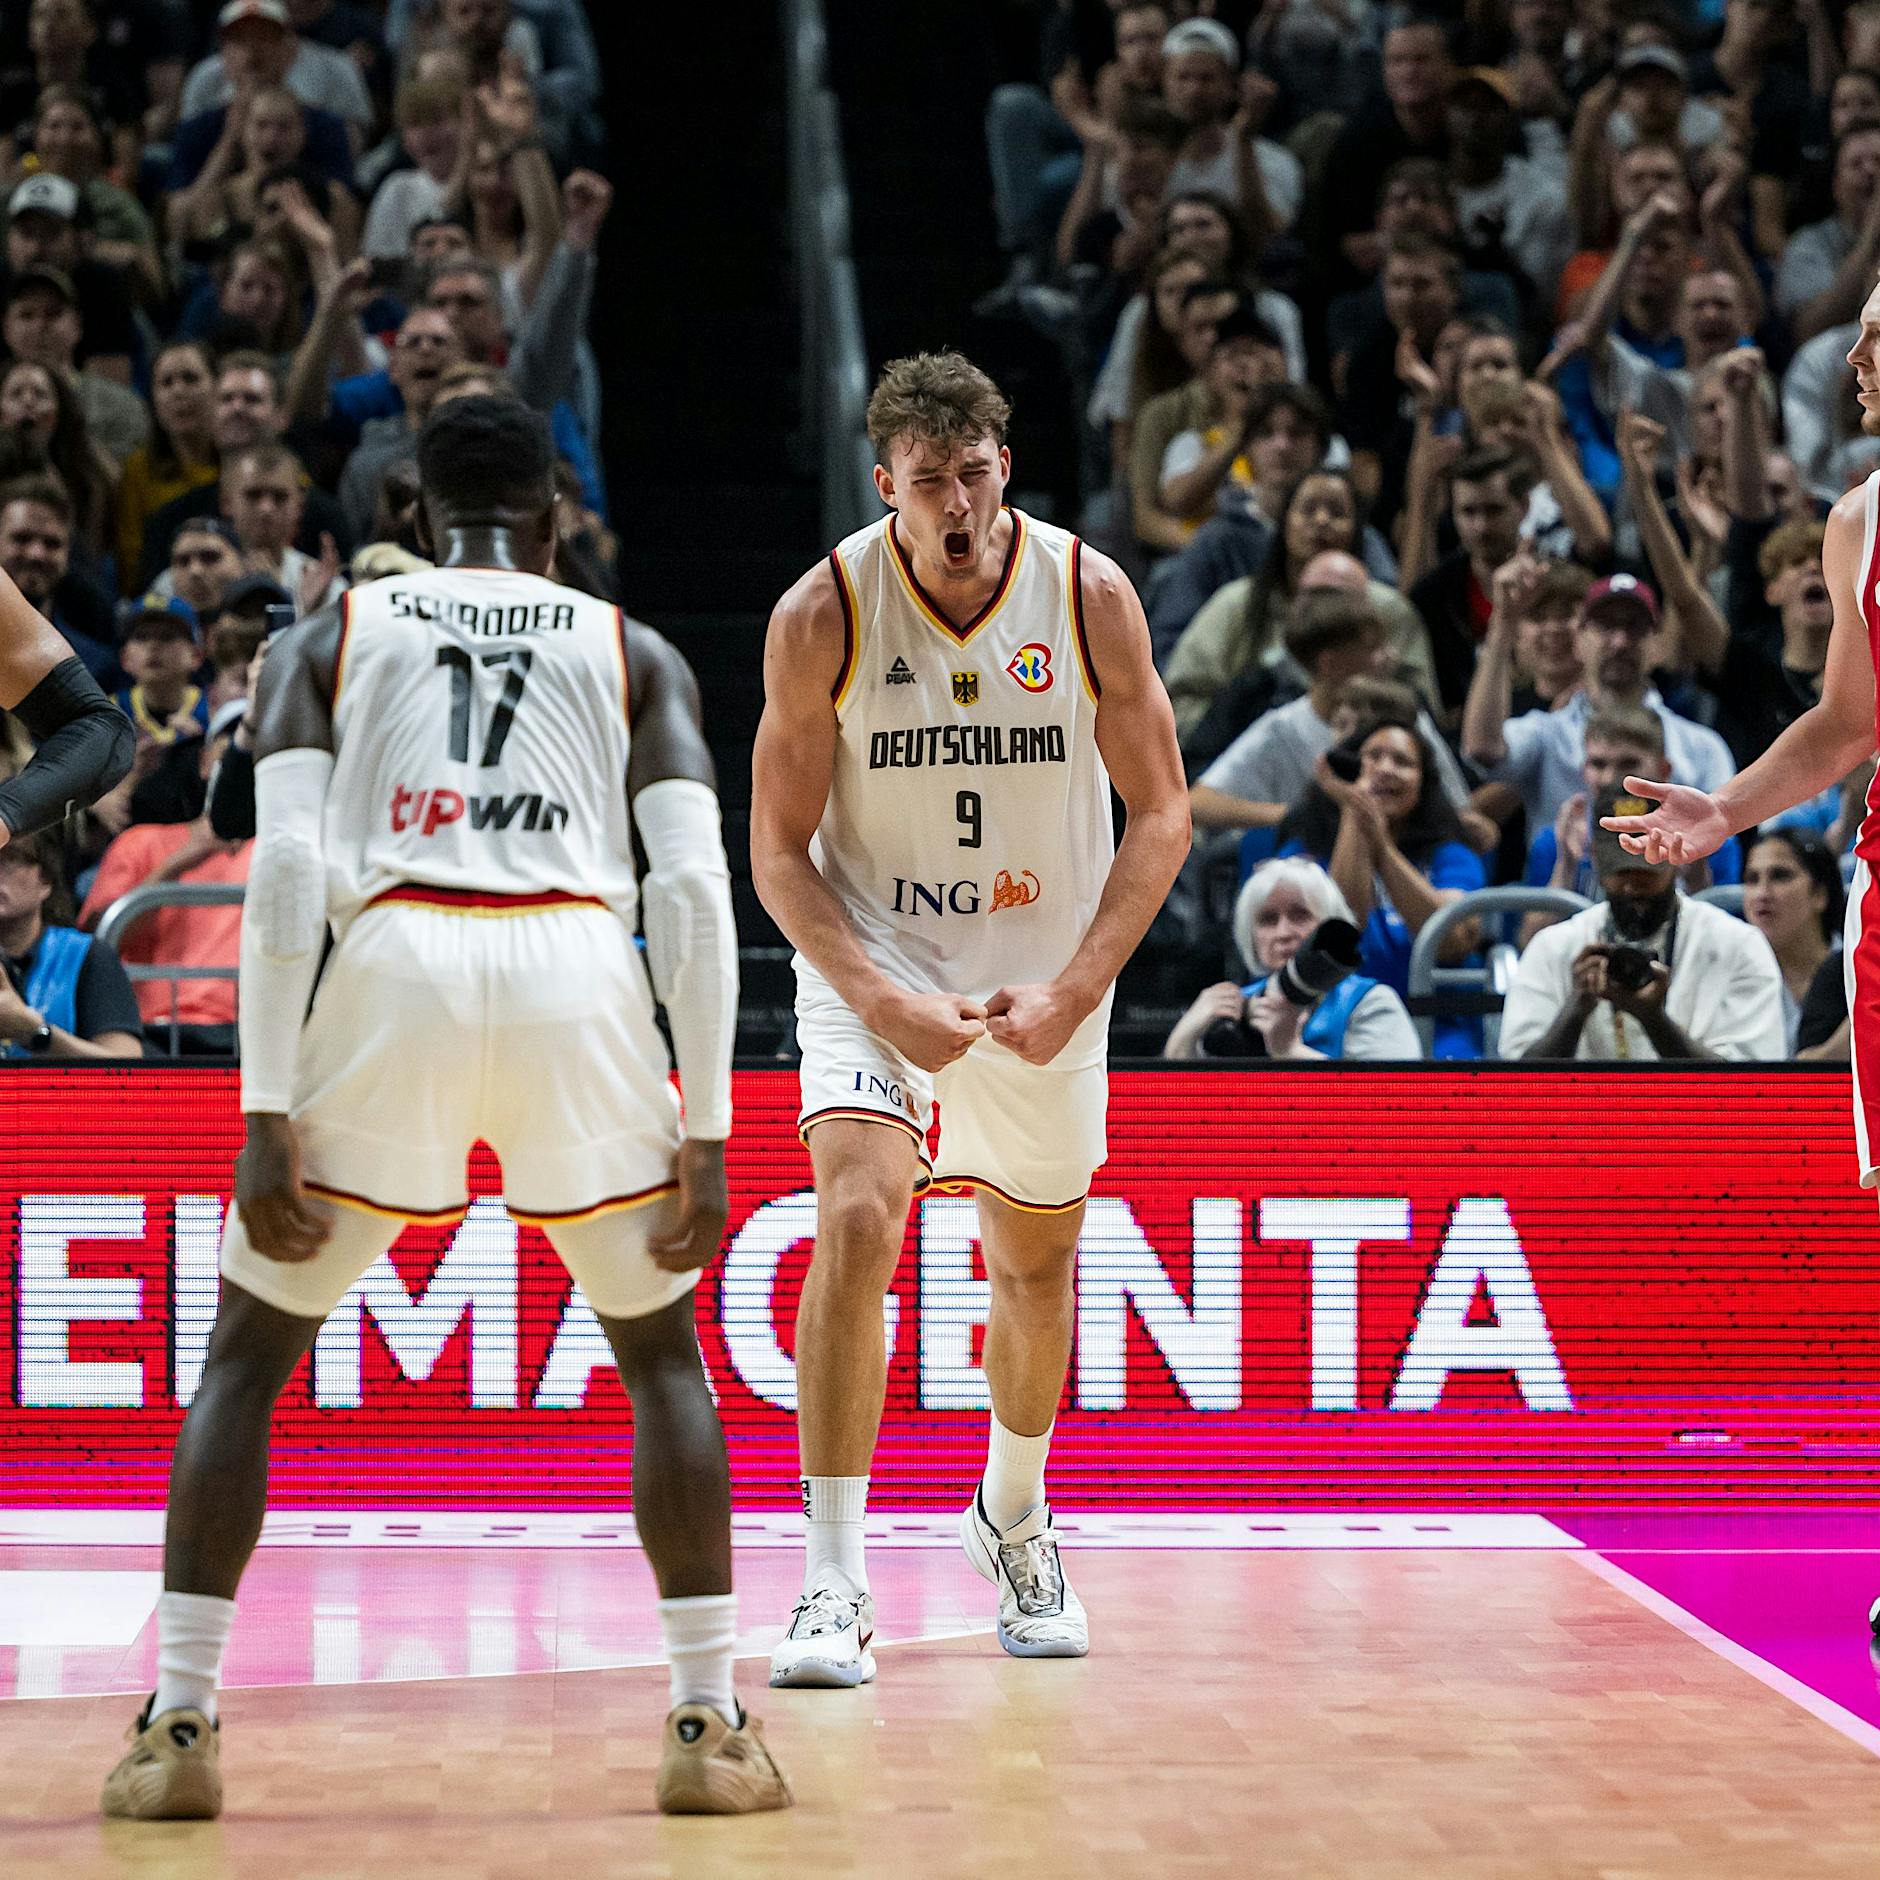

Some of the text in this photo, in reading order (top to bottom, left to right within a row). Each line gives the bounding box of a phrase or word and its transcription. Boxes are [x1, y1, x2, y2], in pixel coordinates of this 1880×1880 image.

[886, 672, 917, 685] PEAK
[436, 645, 532, 768] 17
[869, 724, 1066, 770] DEUTSCHLAND
[955, 790, 982, 849] 9
[890, 877, 981, 916] ING
[852, 1071, 902, 1106] ING
